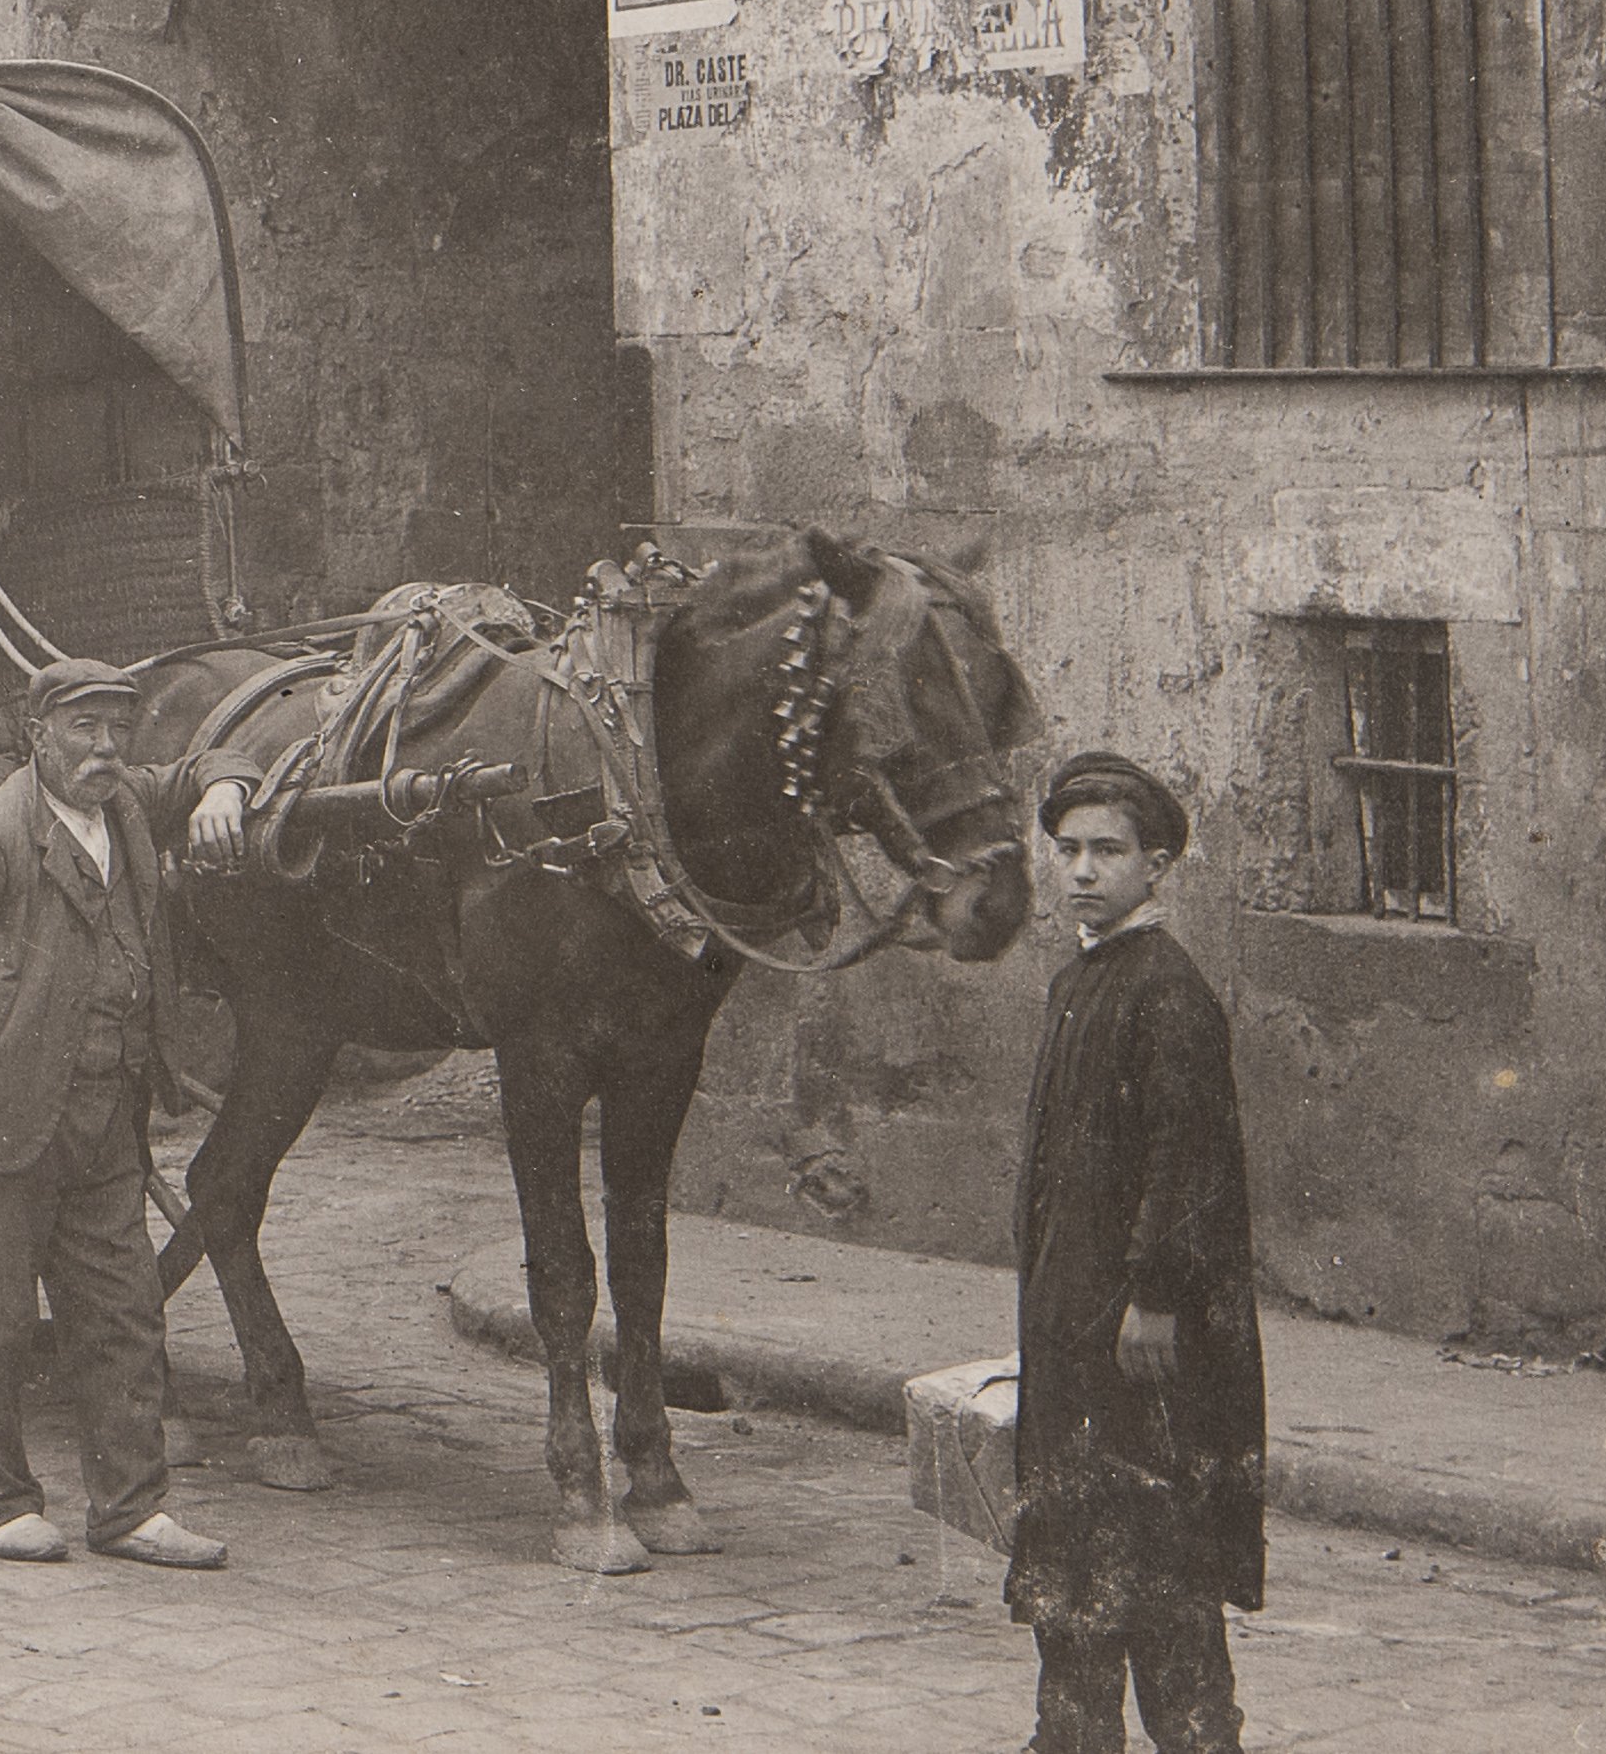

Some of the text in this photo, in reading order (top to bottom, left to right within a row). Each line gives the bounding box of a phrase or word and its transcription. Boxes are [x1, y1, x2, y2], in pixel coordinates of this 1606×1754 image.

[664, 53, 747, 88] DR. CASTE
[658, 102, 732, 132] PLAZA DEL
